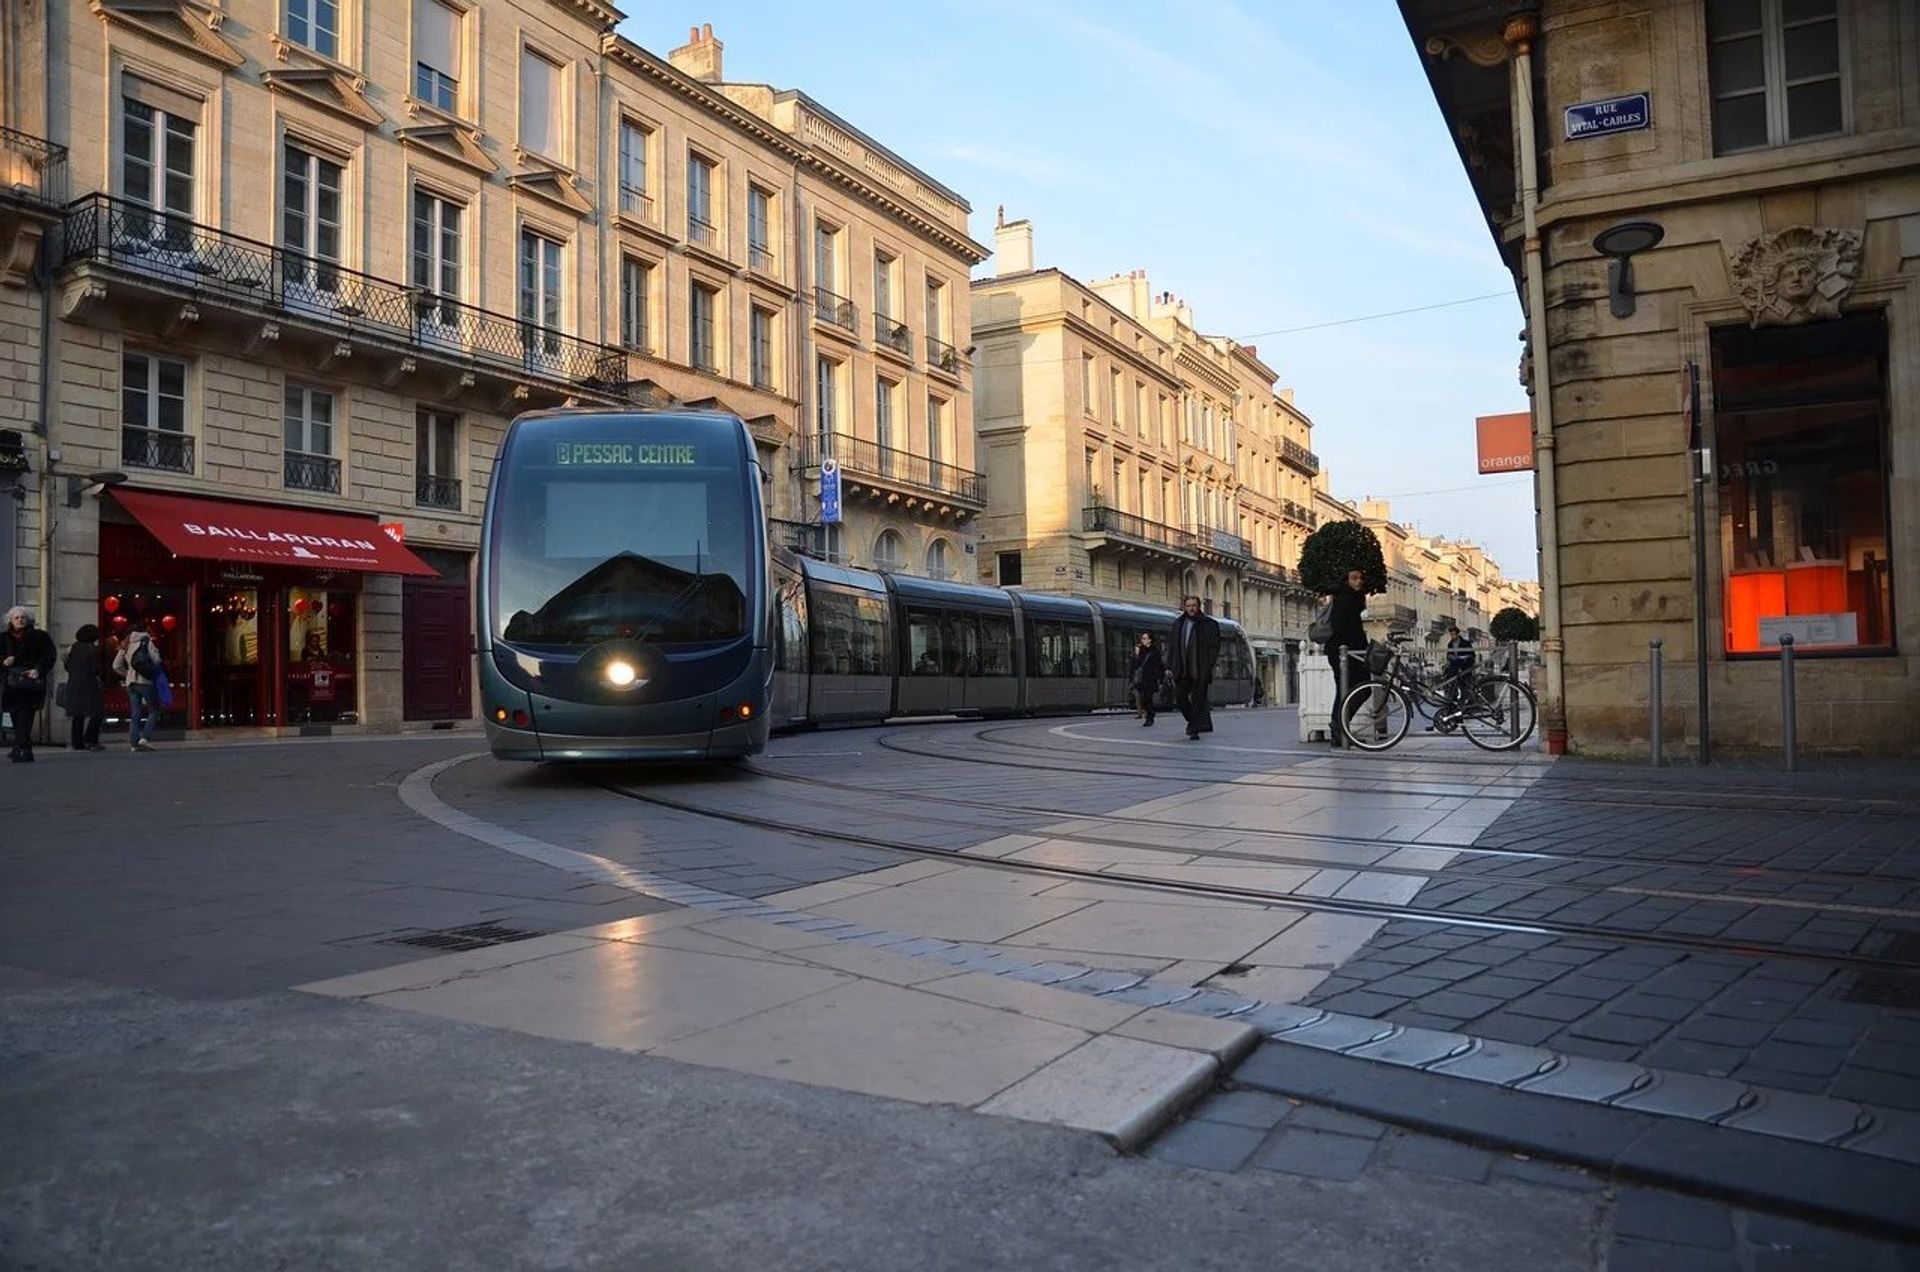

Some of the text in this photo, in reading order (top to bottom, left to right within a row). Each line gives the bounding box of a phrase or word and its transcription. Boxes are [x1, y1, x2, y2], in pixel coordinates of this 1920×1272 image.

[1595, 104, 1617, 115] RUE
[1571, 113, 1641, 132] VITAL-CARLES
[573, 444, 633, 464] PESSAC
[639, 444, 695, 464] CENTRE
[1481, 454, 1531, 469] orange
[183, 523, 376, 551] BAILLARDRAN
